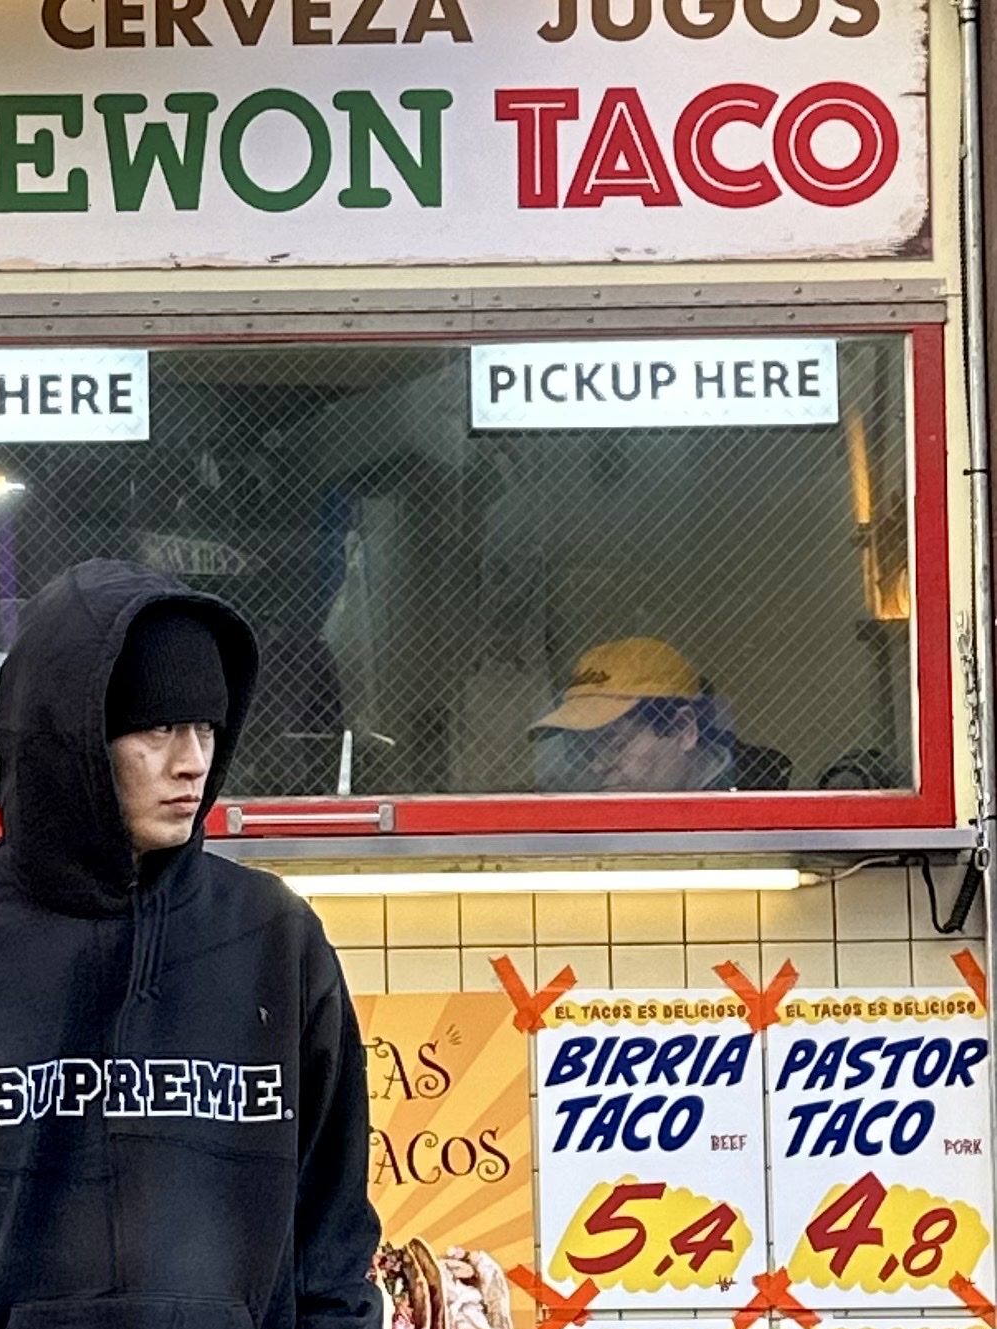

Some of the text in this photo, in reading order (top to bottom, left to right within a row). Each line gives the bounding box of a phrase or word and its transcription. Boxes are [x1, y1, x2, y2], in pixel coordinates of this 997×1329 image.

[41, 0, 473, 49] CERVEZA
[537, 0, 880, 42] JUGOS
[494, 82, 900, 209] TACO
[489, 358, 821, 403] PICKUP HERE
[555, 1003, 747, 1020] EL TACOS ES DELICIOSO
[785, 1001, 977, 1018] EL TACOS ES DELICIOSO
[544, 1032, 757, 1088] BIRRIA
[774, 1036, 988, 1092] PASTOR
[552, 1092, 747, 1153] TACO BEEF
[785, 1097, 983, 1158] TACO PORK
[368, 1126, 511, 1186] ACOS
[565, 1182, 738, 1277] 5,4
[806, 1171, 957, 1284] 4,8
